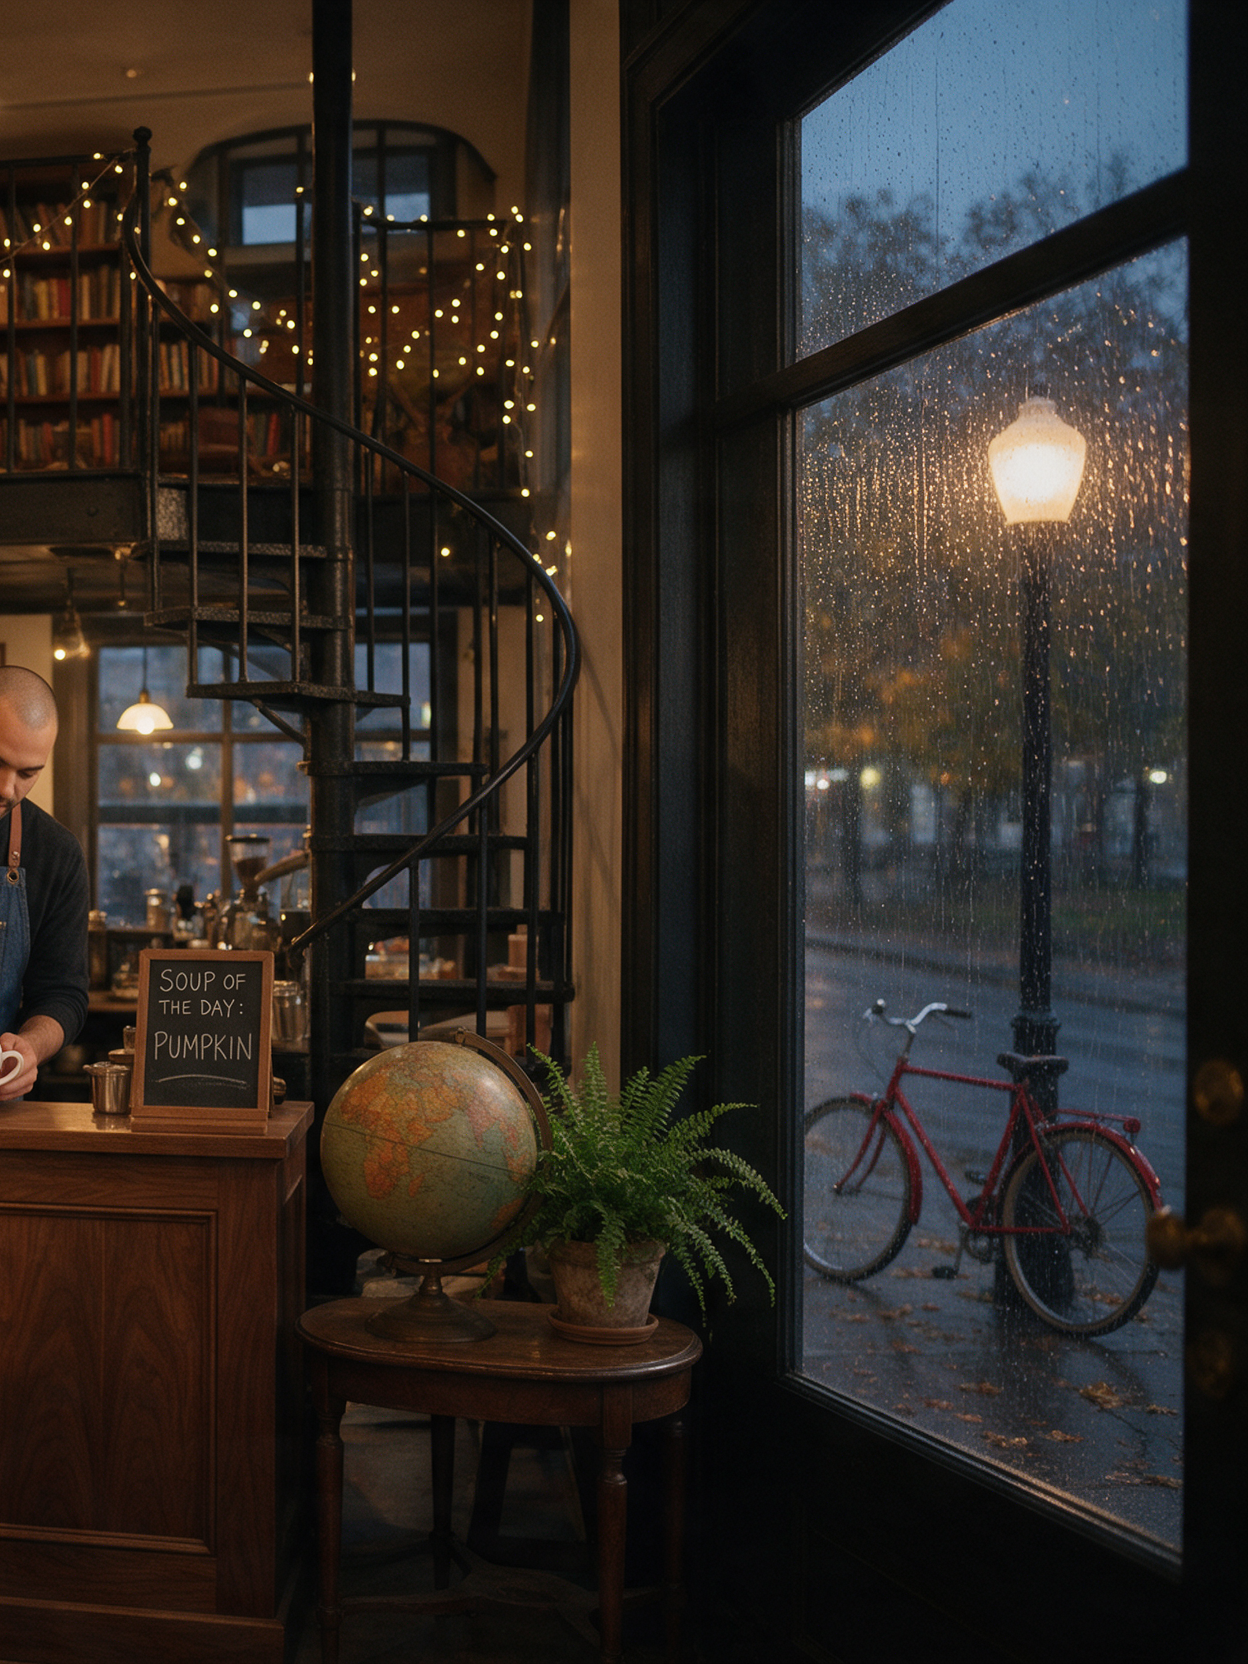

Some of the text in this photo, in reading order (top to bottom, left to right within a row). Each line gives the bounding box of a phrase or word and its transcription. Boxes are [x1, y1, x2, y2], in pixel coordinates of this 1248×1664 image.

[159, 969, 246, 992] SOUP OF
[158, 999, 244, 1018] THE DAY:
[154, 1030, 252, 1061] PUMPKIN
